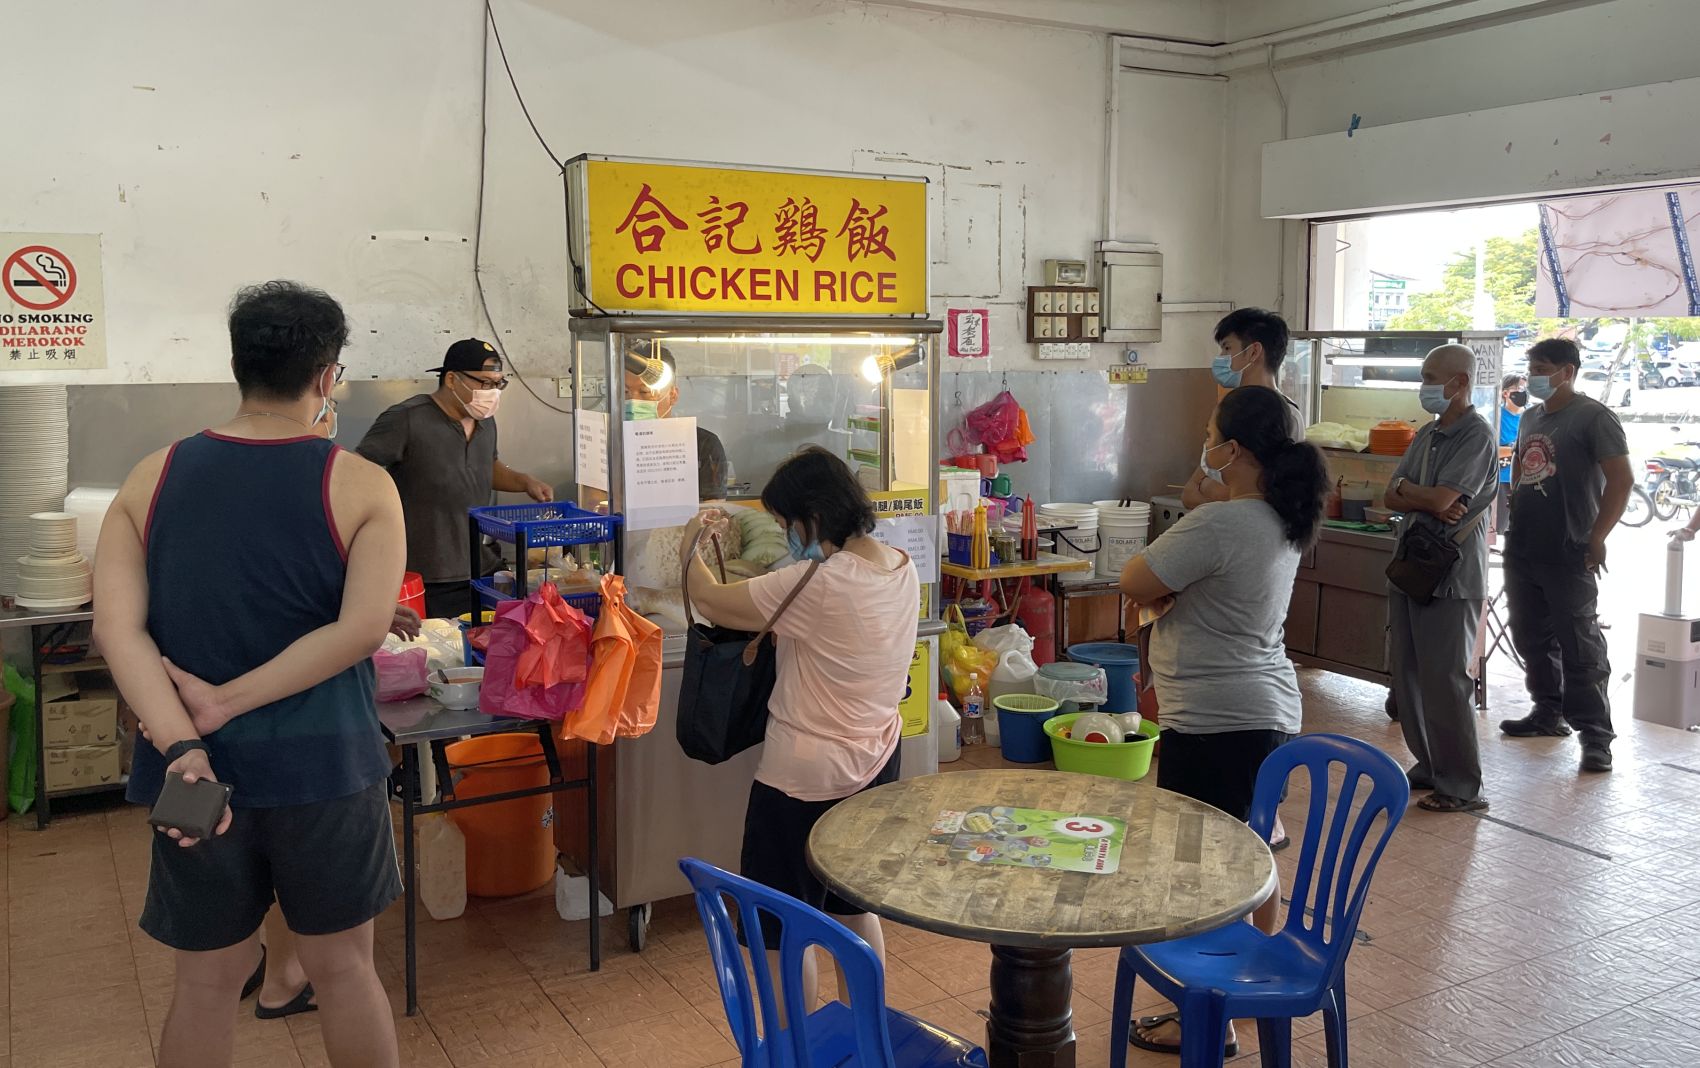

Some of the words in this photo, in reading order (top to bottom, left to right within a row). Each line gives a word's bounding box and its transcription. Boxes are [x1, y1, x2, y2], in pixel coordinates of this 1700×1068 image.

[616, 264, 799, 301] CHICKEN
[814, 270, 898, 303] RICE
[18, 314, 94, 323] SMOKING
[0, 326, 88, 336] DILARANG
[2, 337, 85, 347] MEROKOK
[9, 348, 77, 361] 禁止吸烟
[1471, 344, 1496, 356] WAN
[1065, 821, 1104, 834] 3
